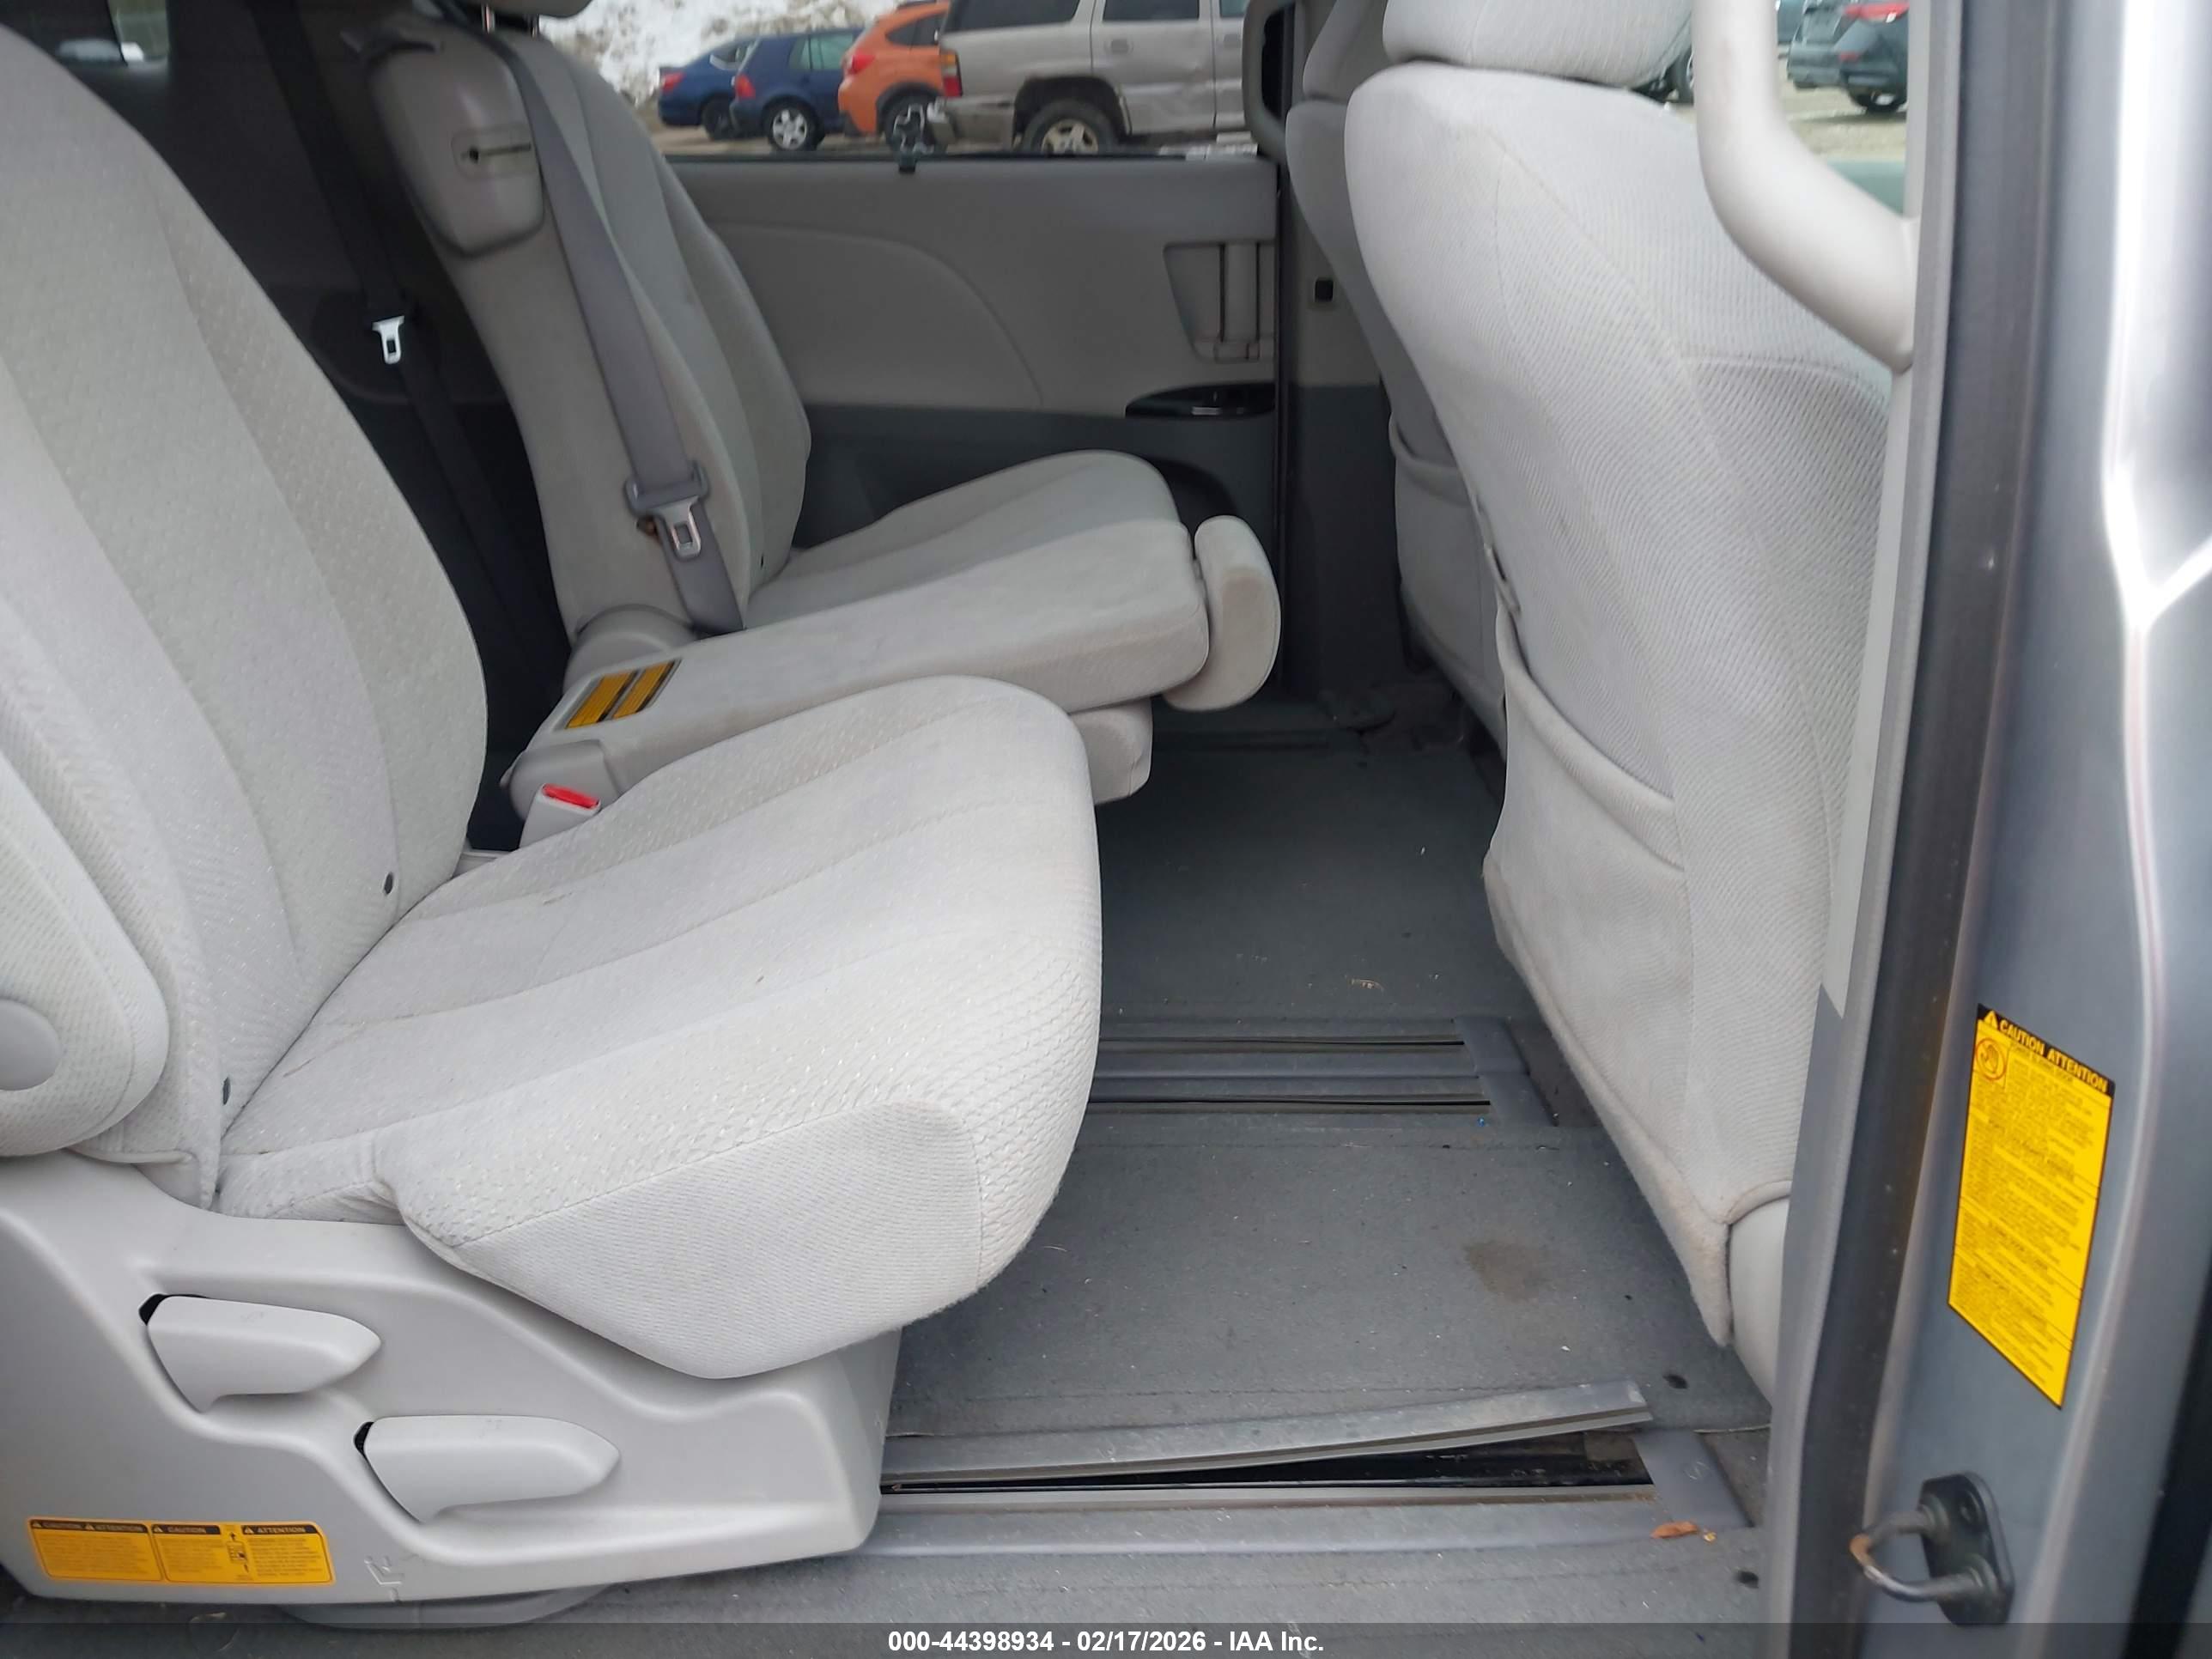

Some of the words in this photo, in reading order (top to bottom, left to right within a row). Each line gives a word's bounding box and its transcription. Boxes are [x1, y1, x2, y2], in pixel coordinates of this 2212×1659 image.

[1999, 1019, 2045, 1055] CAUTION
[2046, 1048, 2108, 1093] ATTENTION
[167, 1526, 207, 1534] CAUTION
[256, 1526, 306, 1534] ATTENTION
